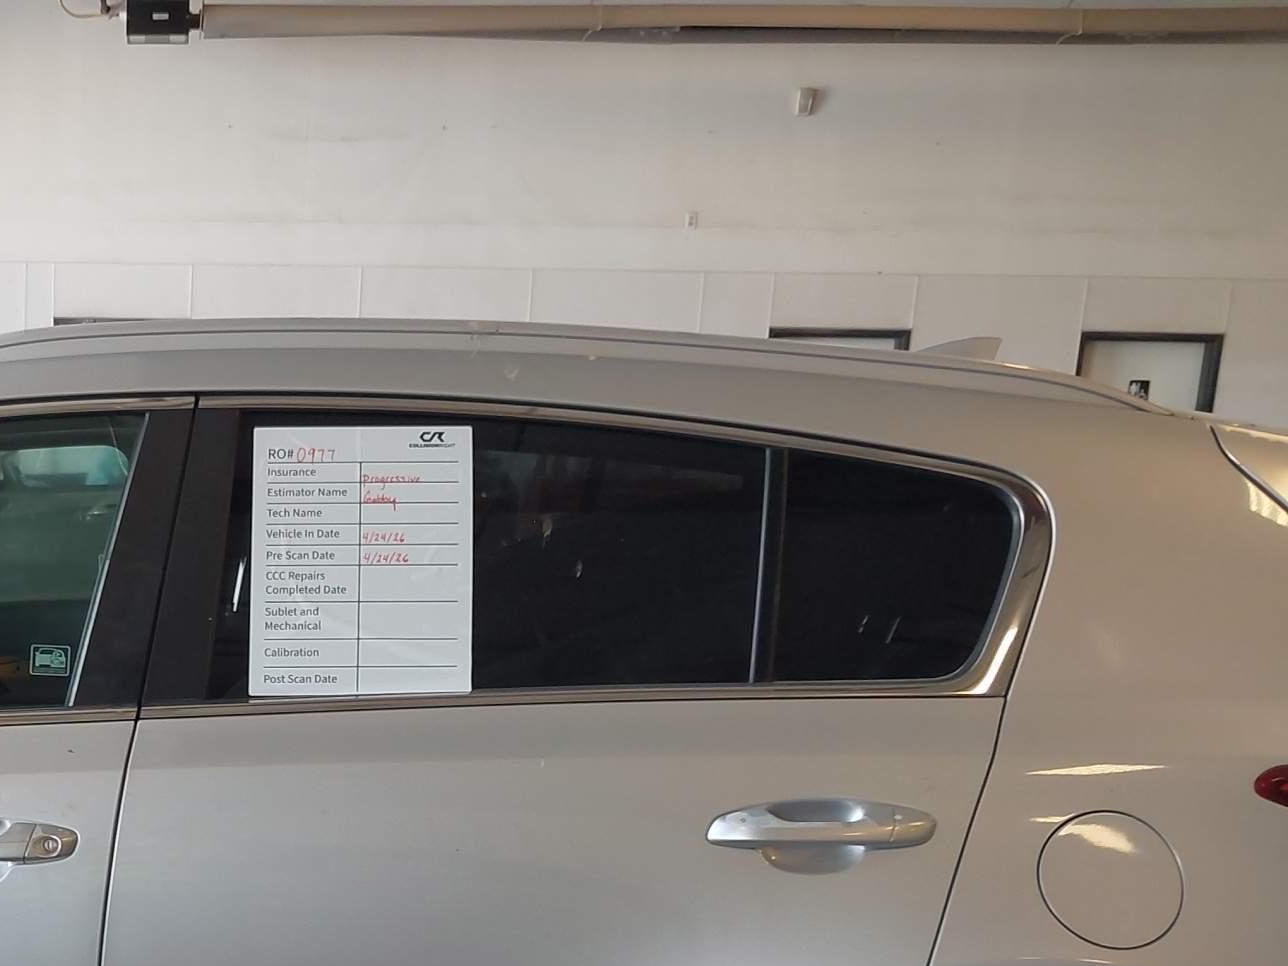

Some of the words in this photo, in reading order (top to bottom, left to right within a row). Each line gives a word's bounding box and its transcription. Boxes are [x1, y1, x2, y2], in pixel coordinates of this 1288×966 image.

[268, 448, 294, 460] RO#
[296, 447, 336, 463] 0977
[267, 468, 317, 477] Insurance
[267, 488, 315, 497] Estimator
[318, 488, 348, 497] Name
[267, 508, 290, 518] Tech
[293, 508, 323, 518] Name
[266, 529, 303, 539] Vehicle
[305, 530, 314, 538] In
[317, 529, 340, 538] Date
[362, 531, 405, 544] 4/24/26
[266, 551, 283, 561] Pre
[285, 550, 310, 560] Scan
[312, 551, 336, 560] Date
[363, 551, 409, 564] 4/24/26
[265, 571, 286, 581] CCC
[288, 571, 326, 582] Repairs
[265, 585, 321, 596] Completed
[323, 585, 347, 594] Date
[265, 607, 298, 616] Sublet
[299, 606, 320, 616] and
[264, 620, 322, 631] Mechanical
[264, 647, 320, 657] Calibration
[263, 674, 286, 684] Post
[287, 674, 312, 684] Scan
[314, 674, 338, 684] Date
